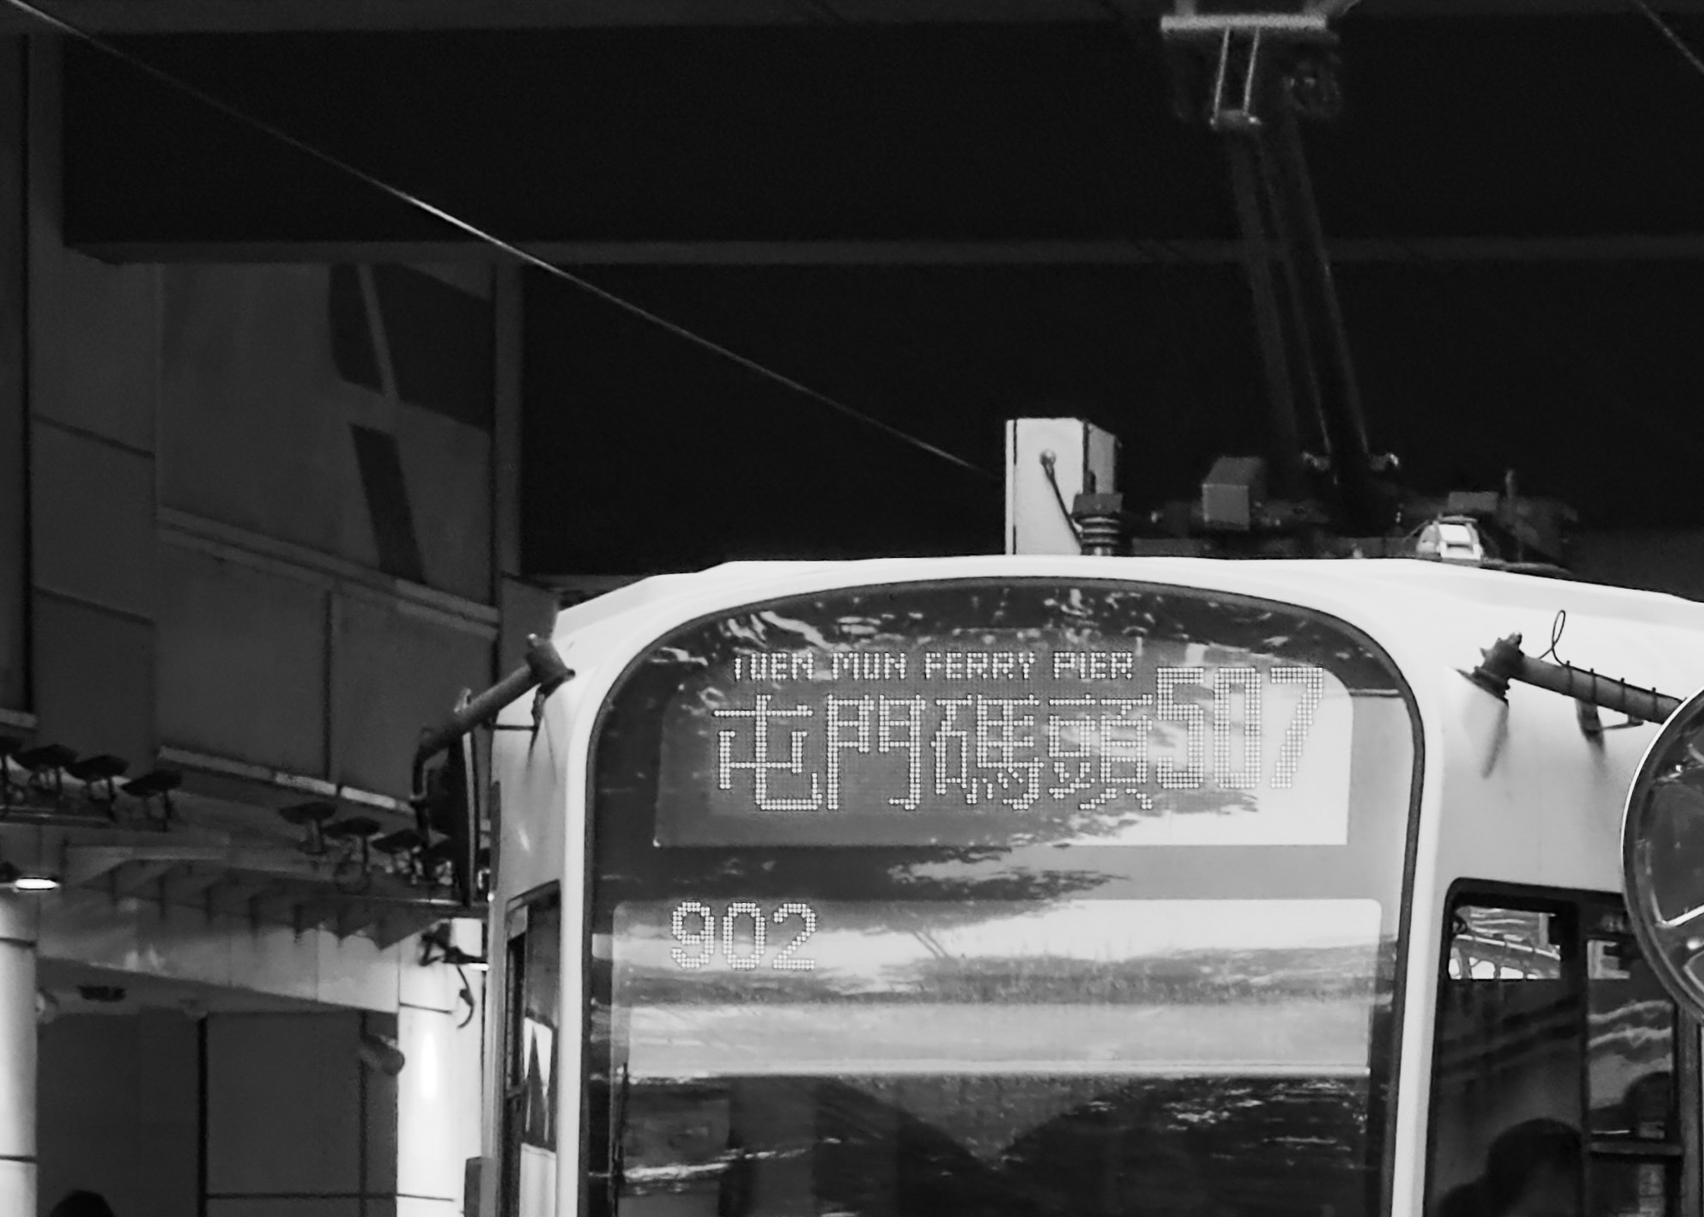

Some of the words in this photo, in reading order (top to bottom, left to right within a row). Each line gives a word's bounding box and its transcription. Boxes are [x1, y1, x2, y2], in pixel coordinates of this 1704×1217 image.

[832, 652, 906, 680] MUN
[925, 652, 1035, 679] FERRY
[1054, 652, 1133, 679] PIER
[713, 695, 1153, 809] 屯門碼頭
[1157, 667, 1323, 789] 507
[672, 901, 816, 969] 902
